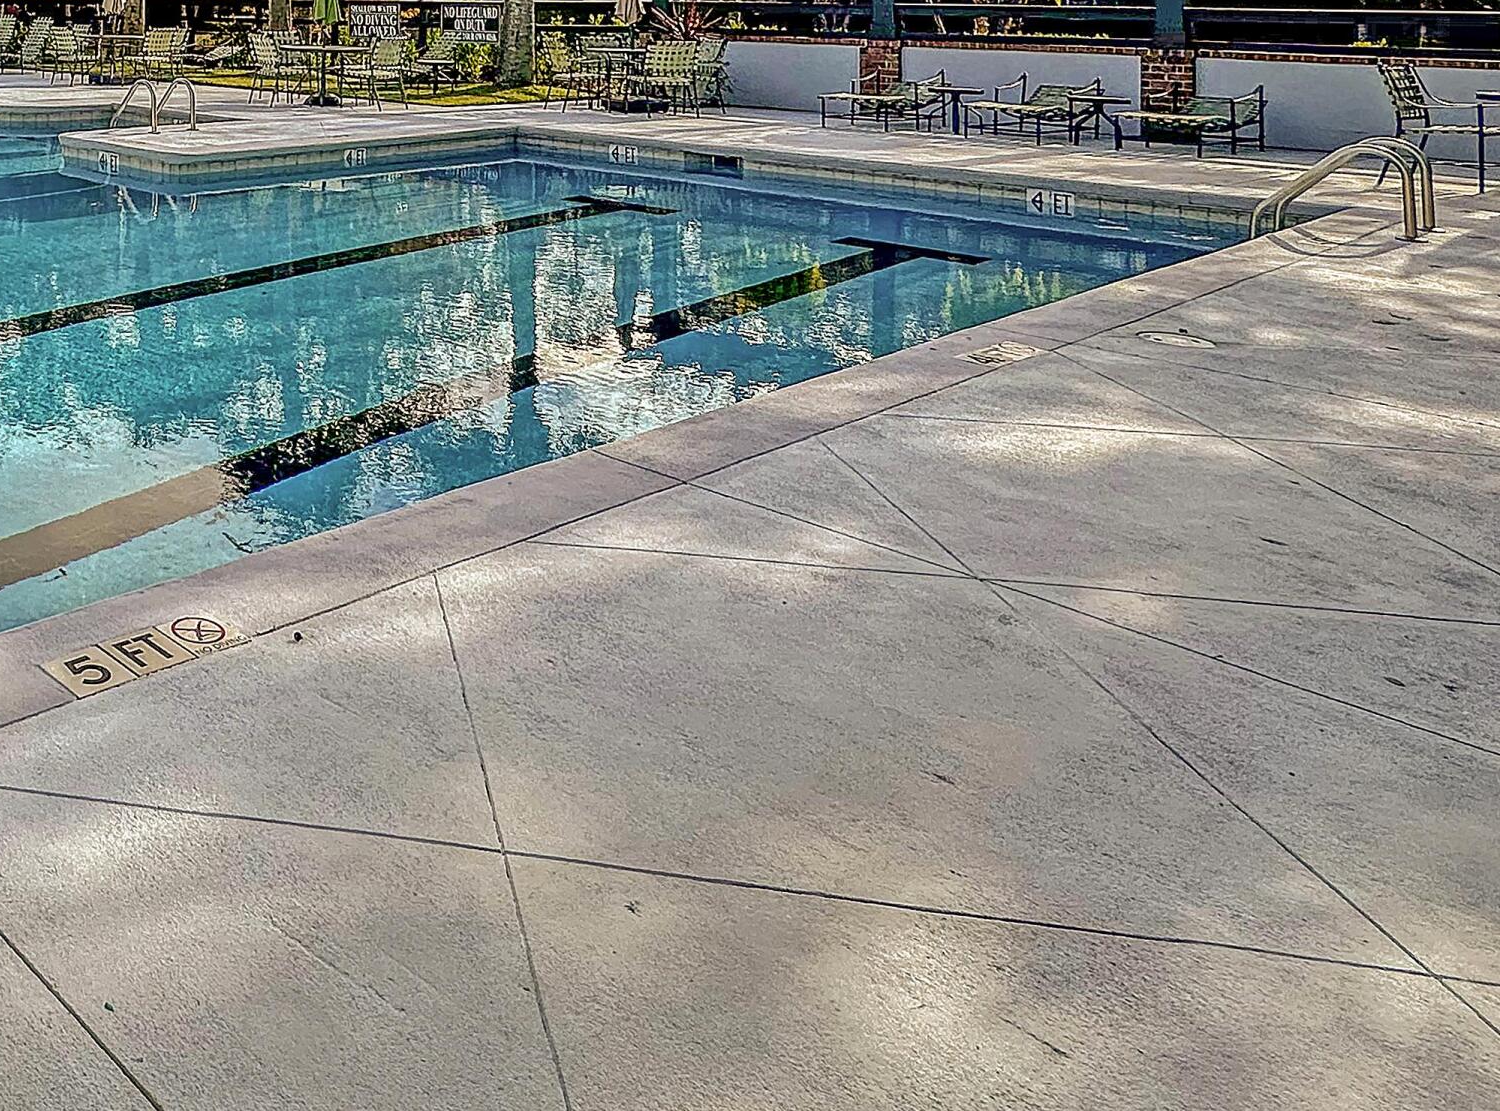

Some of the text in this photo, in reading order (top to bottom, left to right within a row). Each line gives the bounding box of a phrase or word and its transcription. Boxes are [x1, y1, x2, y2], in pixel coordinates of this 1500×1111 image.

[444, 6, 498, 19] NO LIFEGUARD
[350, 14, 397, 26] NO DIVING
[454, 18, 487, 31] ON DUTY
[351, 25, 397, 37] ALLOWED
[194, 634, 248, 655] NO DIVING
[63, 632, 174, 685] 5 FT
